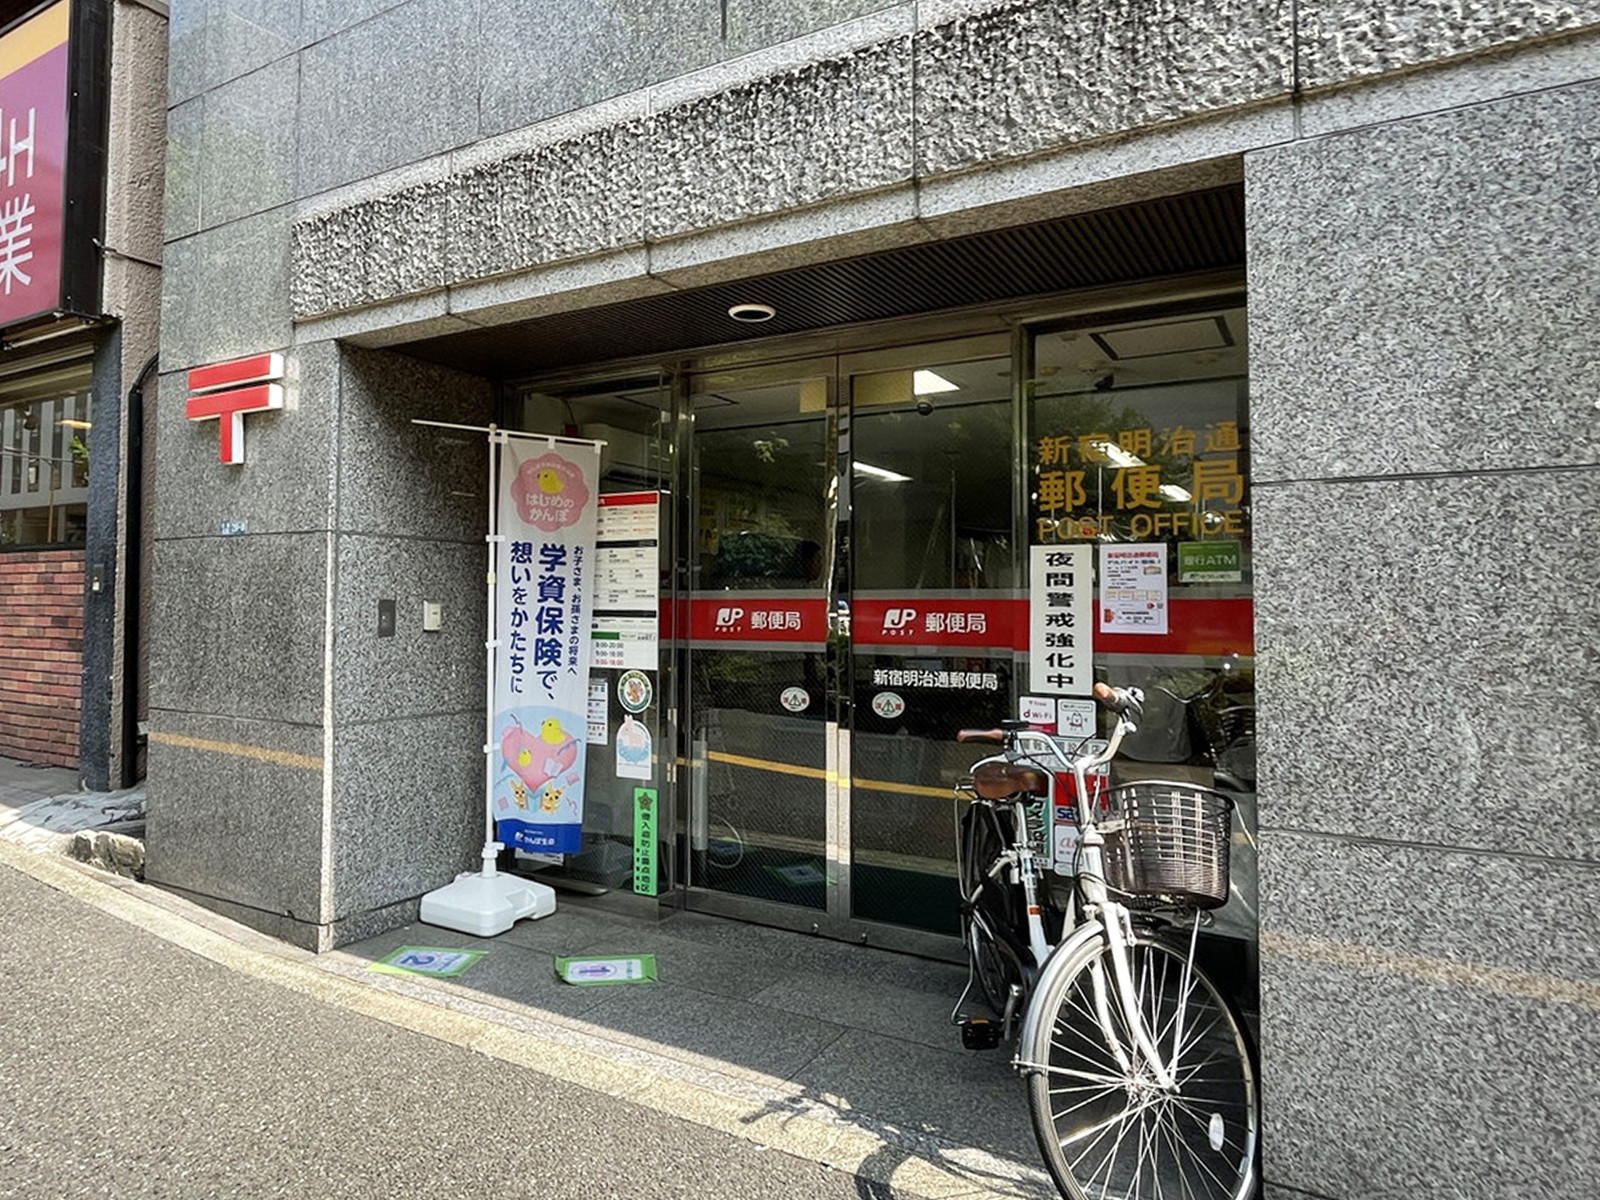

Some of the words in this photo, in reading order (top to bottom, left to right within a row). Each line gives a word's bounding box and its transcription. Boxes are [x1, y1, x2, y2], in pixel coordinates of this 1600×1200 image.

[1039, 421, 1241, 465] 新宿明治通
[525, 493, 575, 508] はじめの
[1039, 459, 1245, 513] 郵便局
[1036, 515, 1114, 541] POST
[1130, 510, 1245, 537] OFFICE
[510, 541, 533, 694] 想いをかたちに
[533, 543, 567, 700] 学資保険で、
[567, 546, 584, 675] お子さま、お孫さまの将来へ
[751, 611, 801, 630] 郵便局
[925, 612, 986, 634] 郵便局
[1045, 552, 1075, 688] 夜間警戒強化中
[873, 669, 998, 691] 新宿明治通郵便局
